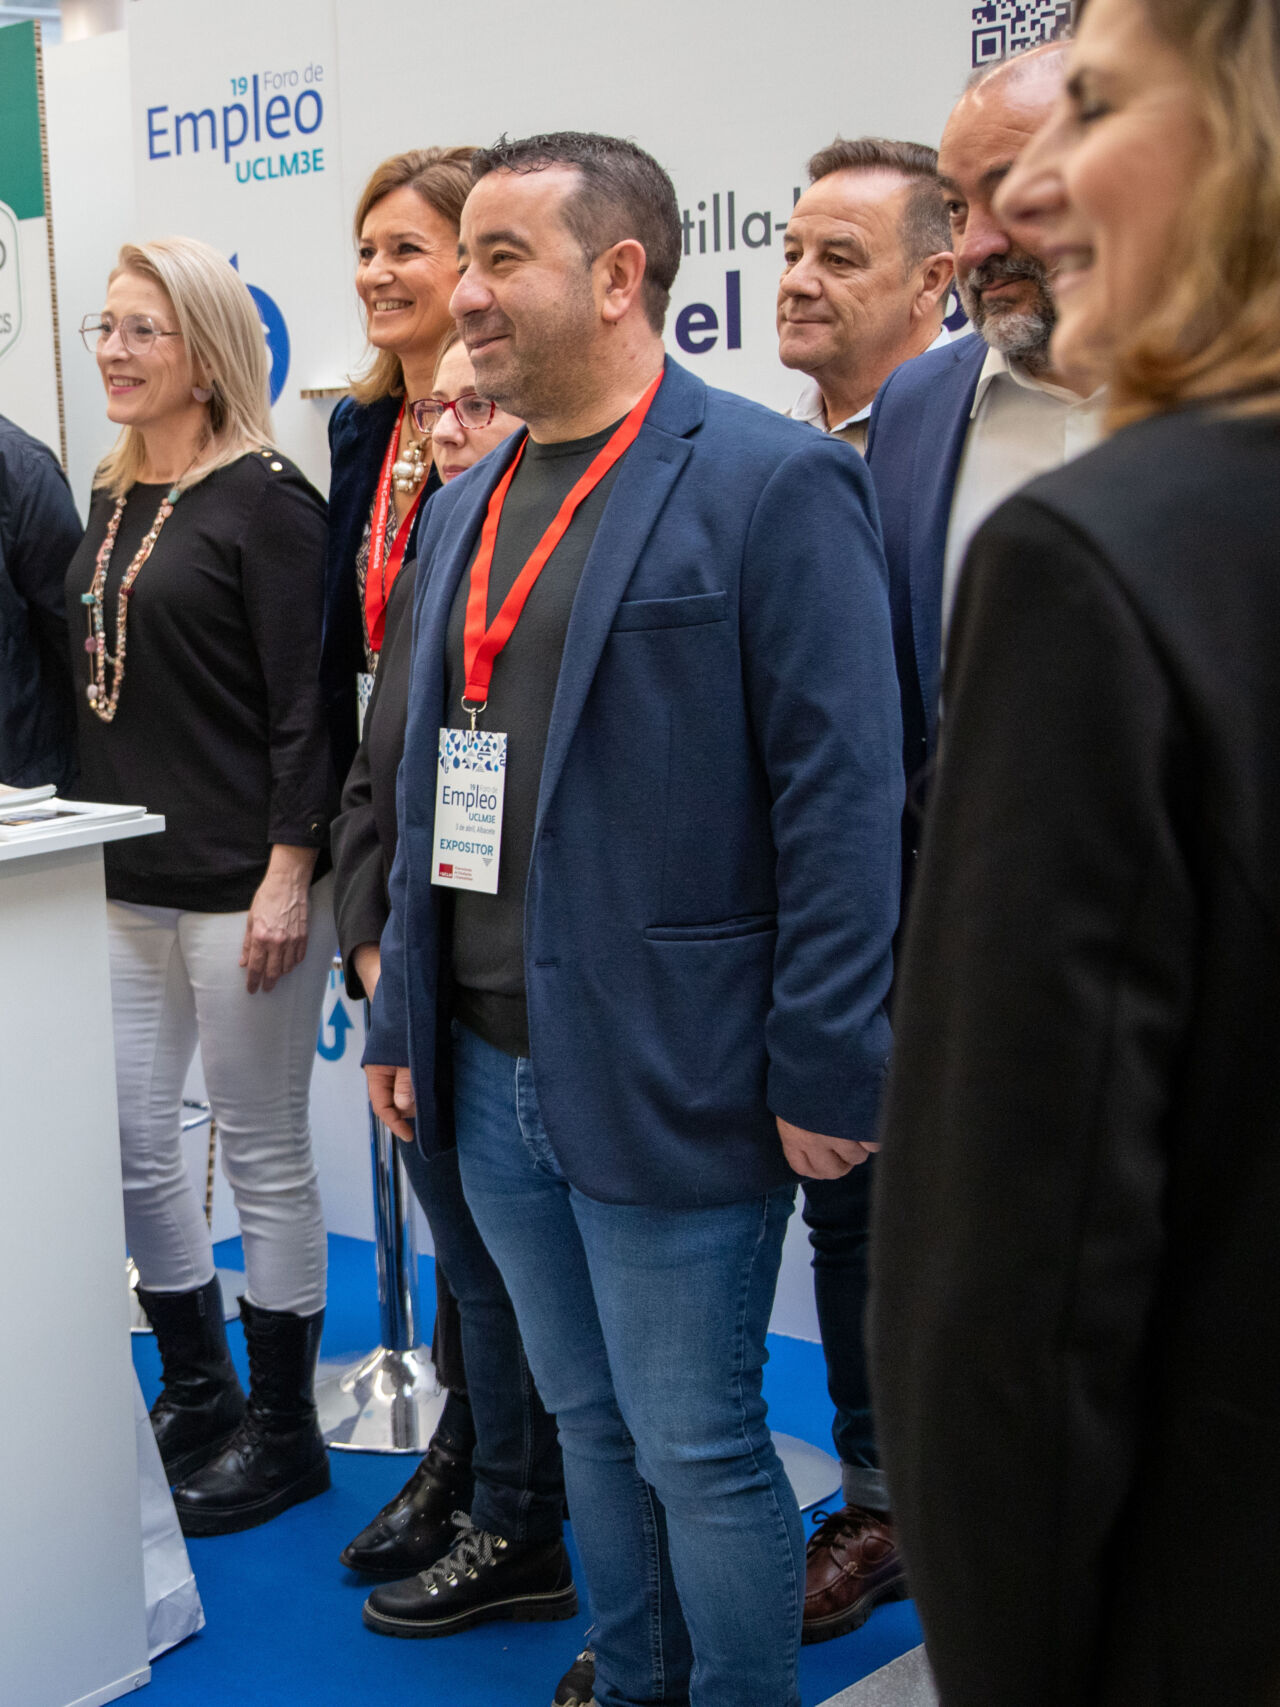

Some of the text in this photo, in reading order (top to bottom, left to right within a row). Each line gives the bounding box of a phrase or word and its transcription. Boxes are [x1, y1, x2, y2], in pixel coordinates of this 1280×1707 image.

[230, 62, 324, 96] 19 Foro de
[147, 73, 324, 165] Empleo
[235, 147, 326, 184] UCLM3E
[681, 186, 803, 257] tilla-
[674, 269, 743, 355] el
[442, 784, 497, 812] Empleo
[468, 812, 496, 824] UCLM3E
[440, 838, 494, 857] EXPOSITOR
